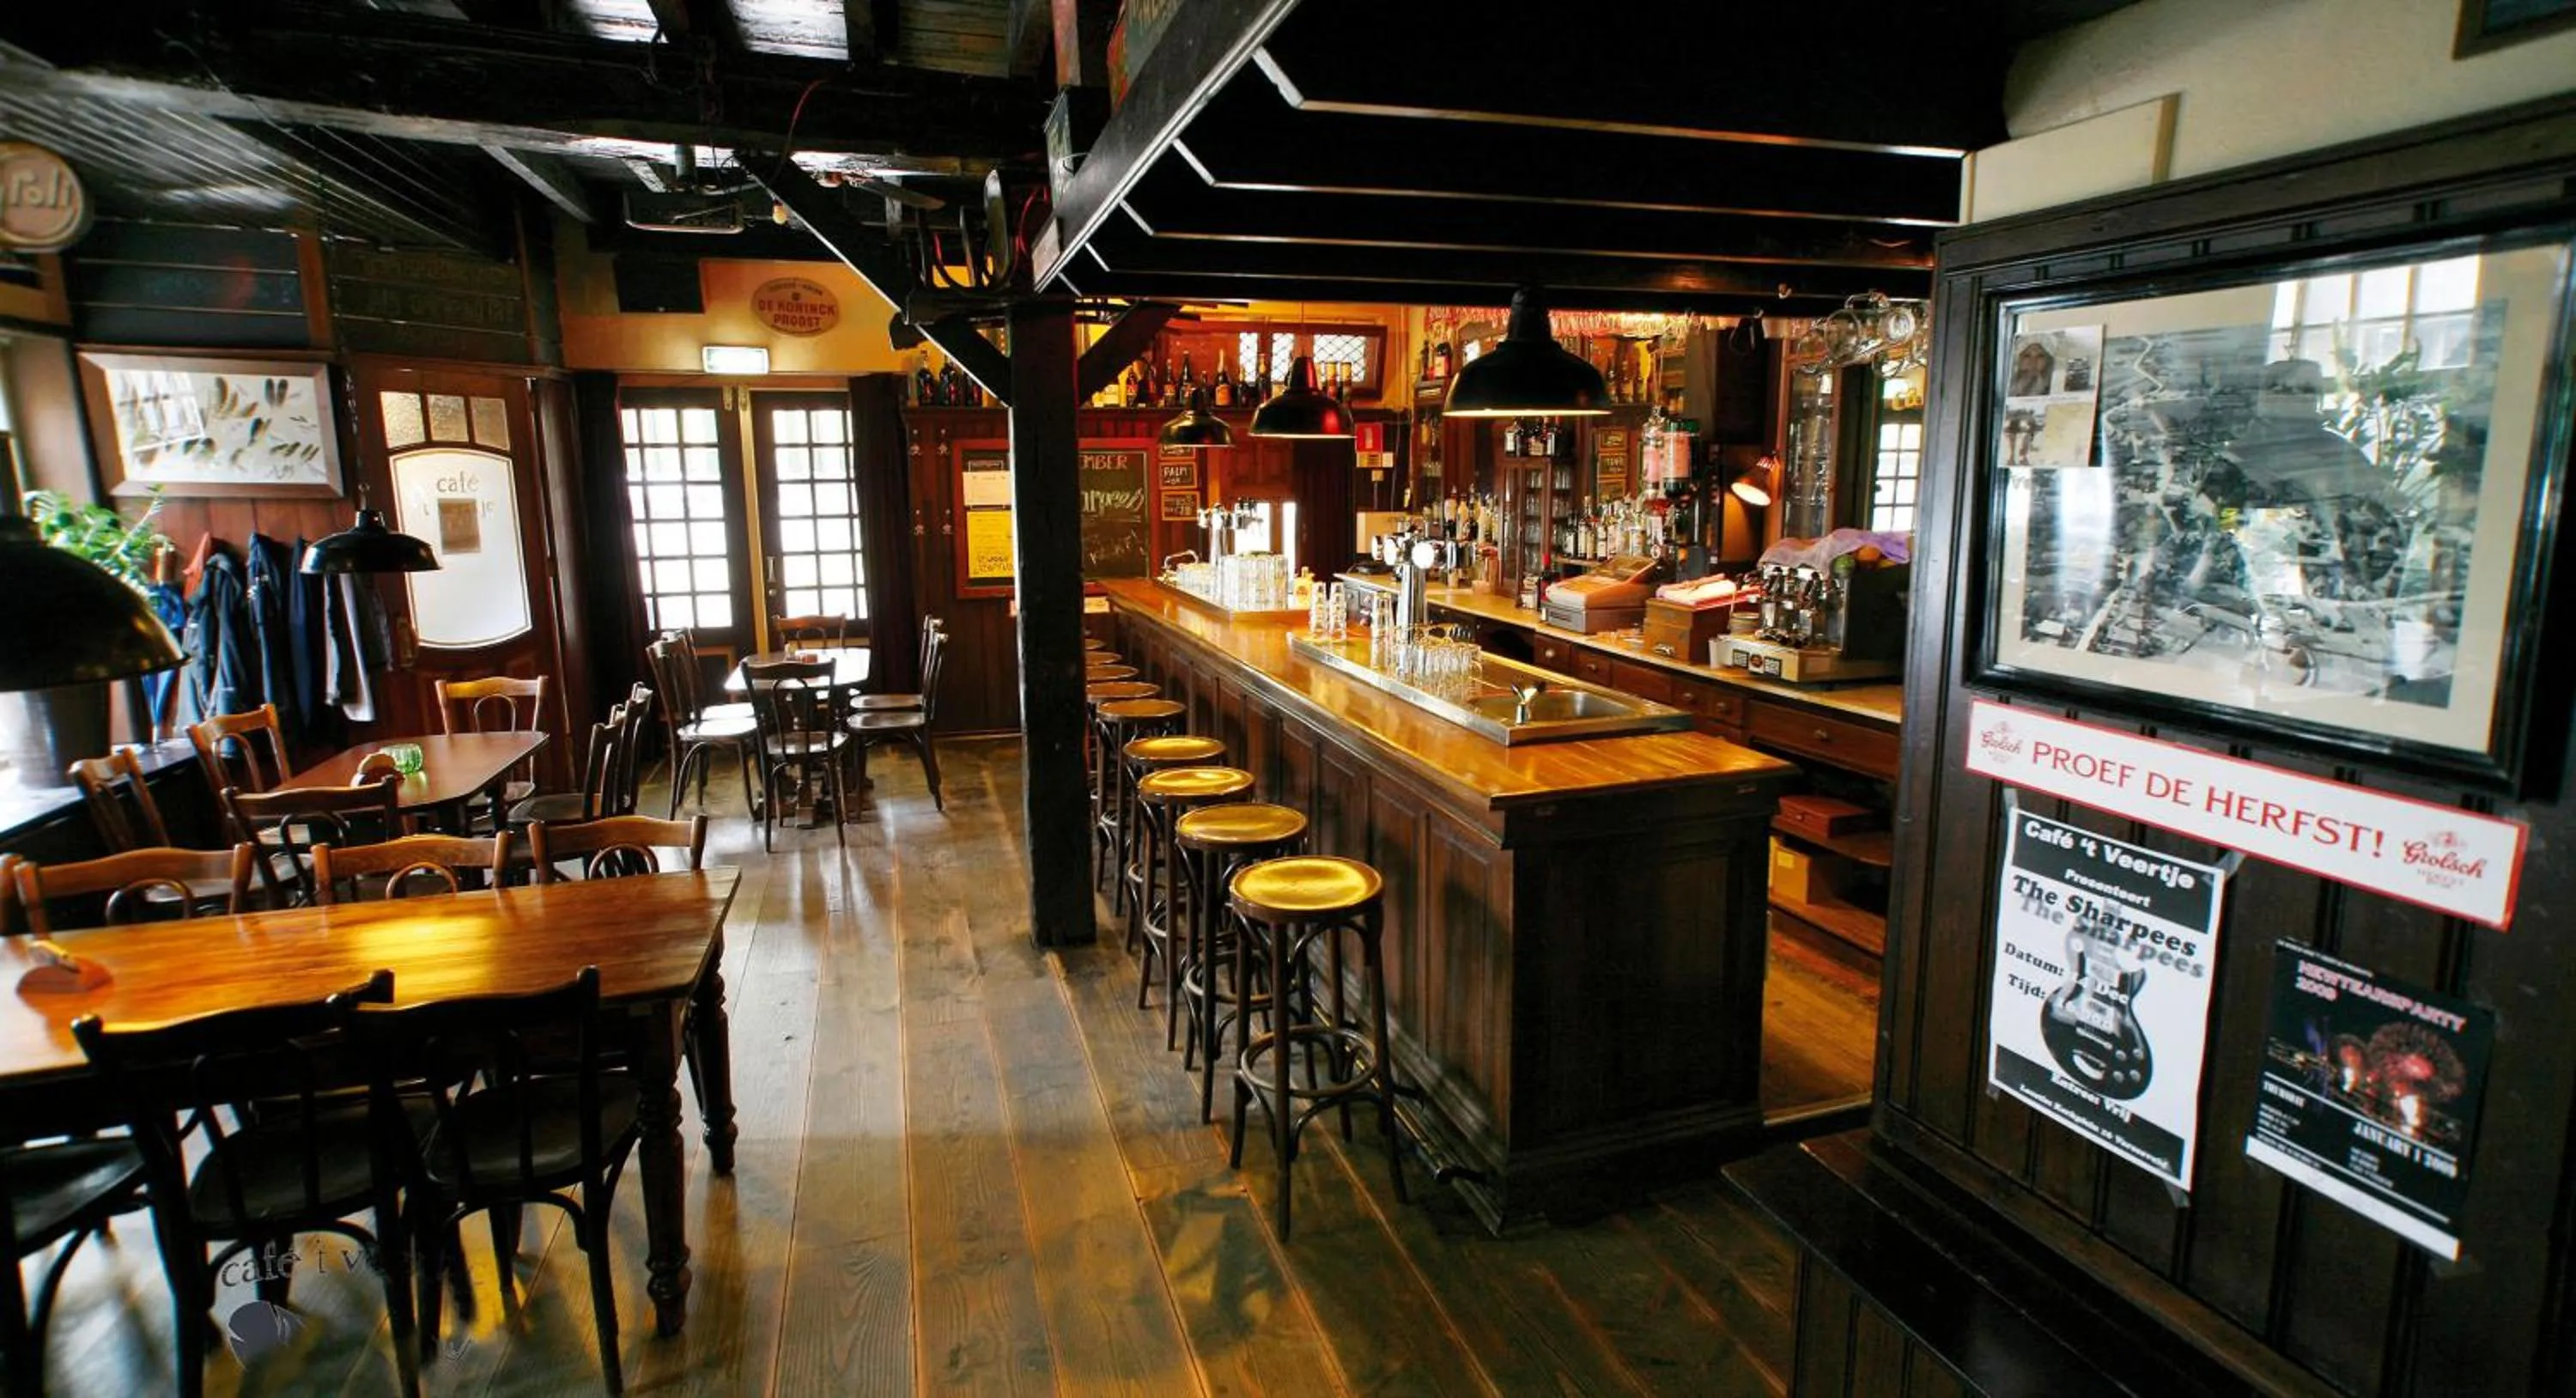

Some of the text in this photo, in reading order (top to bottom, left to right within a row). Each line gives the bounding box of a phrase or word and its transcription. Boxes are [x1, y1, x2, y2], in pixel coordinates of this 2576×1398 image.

[758, 300, 774, 312] DE
[2032, 741, 2385, 858] PROEF DE HERFST!
[2025, 820, 2075, 850] Café
[2103, 845, 2195, 890] Veertje
[2403, 840, 2487, 878] Grolsch
[2013, 874, 2196, 957] The Sharpees
[2004, 942, 2064, 976] Datum:
[2008, 974, 2046, 1000] Tijd:
